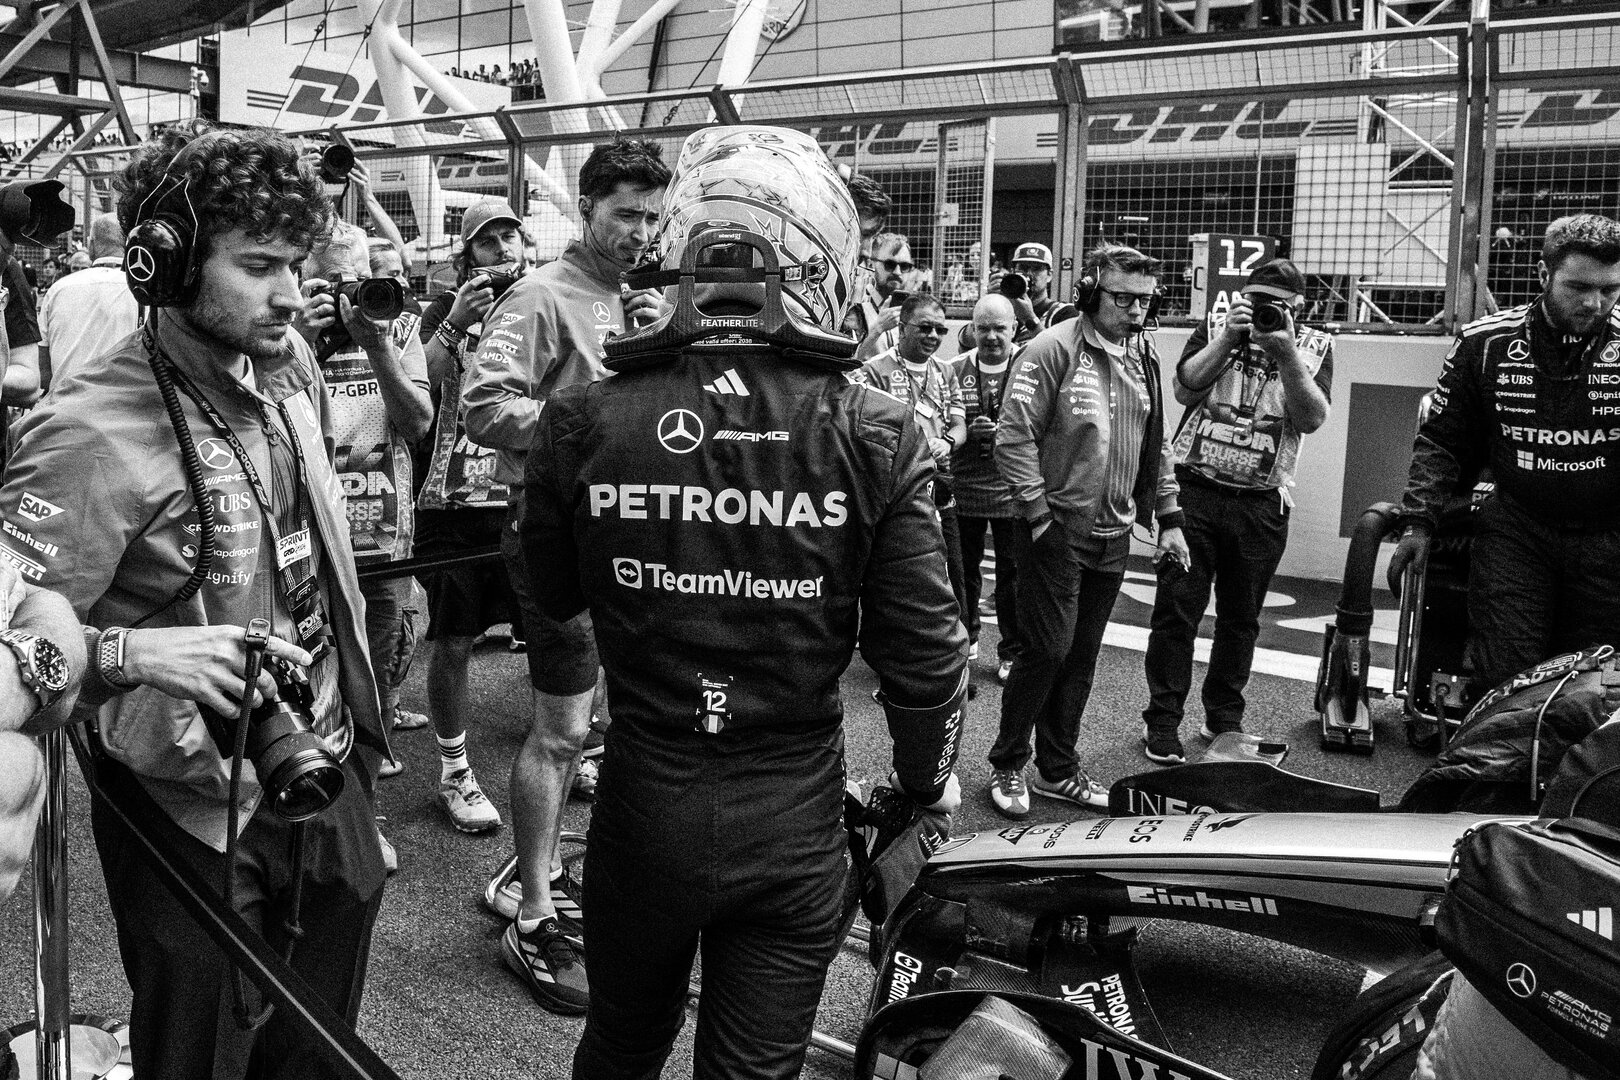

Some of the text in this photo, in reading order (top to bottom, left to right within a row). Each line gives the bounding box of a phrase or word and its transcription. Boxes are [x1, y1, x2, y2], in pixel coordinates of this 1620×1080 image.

[1086, 101, 1309, 145] DHL
[1218, 238, 1265, 277] 12
[700, 319, 759, 328] FEATHERLITE
[328, 381, 378, 398] 7-GBR
[1511, 374, 1534, 386] UBS
[736, 430, 790, 443] AMG
[1500, 422, 1620, 446] PETRONAS
[225, 432, 259, 483] PADDOCK
[1537, 456, 1607, 472] Microsoft
[20, 497, 52, 519] SAP
[219, 491, 252, 513] UBS
[589, 484, 848, 527] PETRONAS
[187, 520, 260, 534] CRWDSTRIKE
[2, 520, 59, 558] Einhell
[279, 530, 309, 551] SPRINT
[645, 563, 824, 599] TeamViewer
[702, 690, 727, 713] 12
[1126, 885, 1279, 916] Einhell
[1540, 991, 1610, 1032] PETRONAS
[1546, 1004, 1606, 1039] FORMULA ONE TEAM
